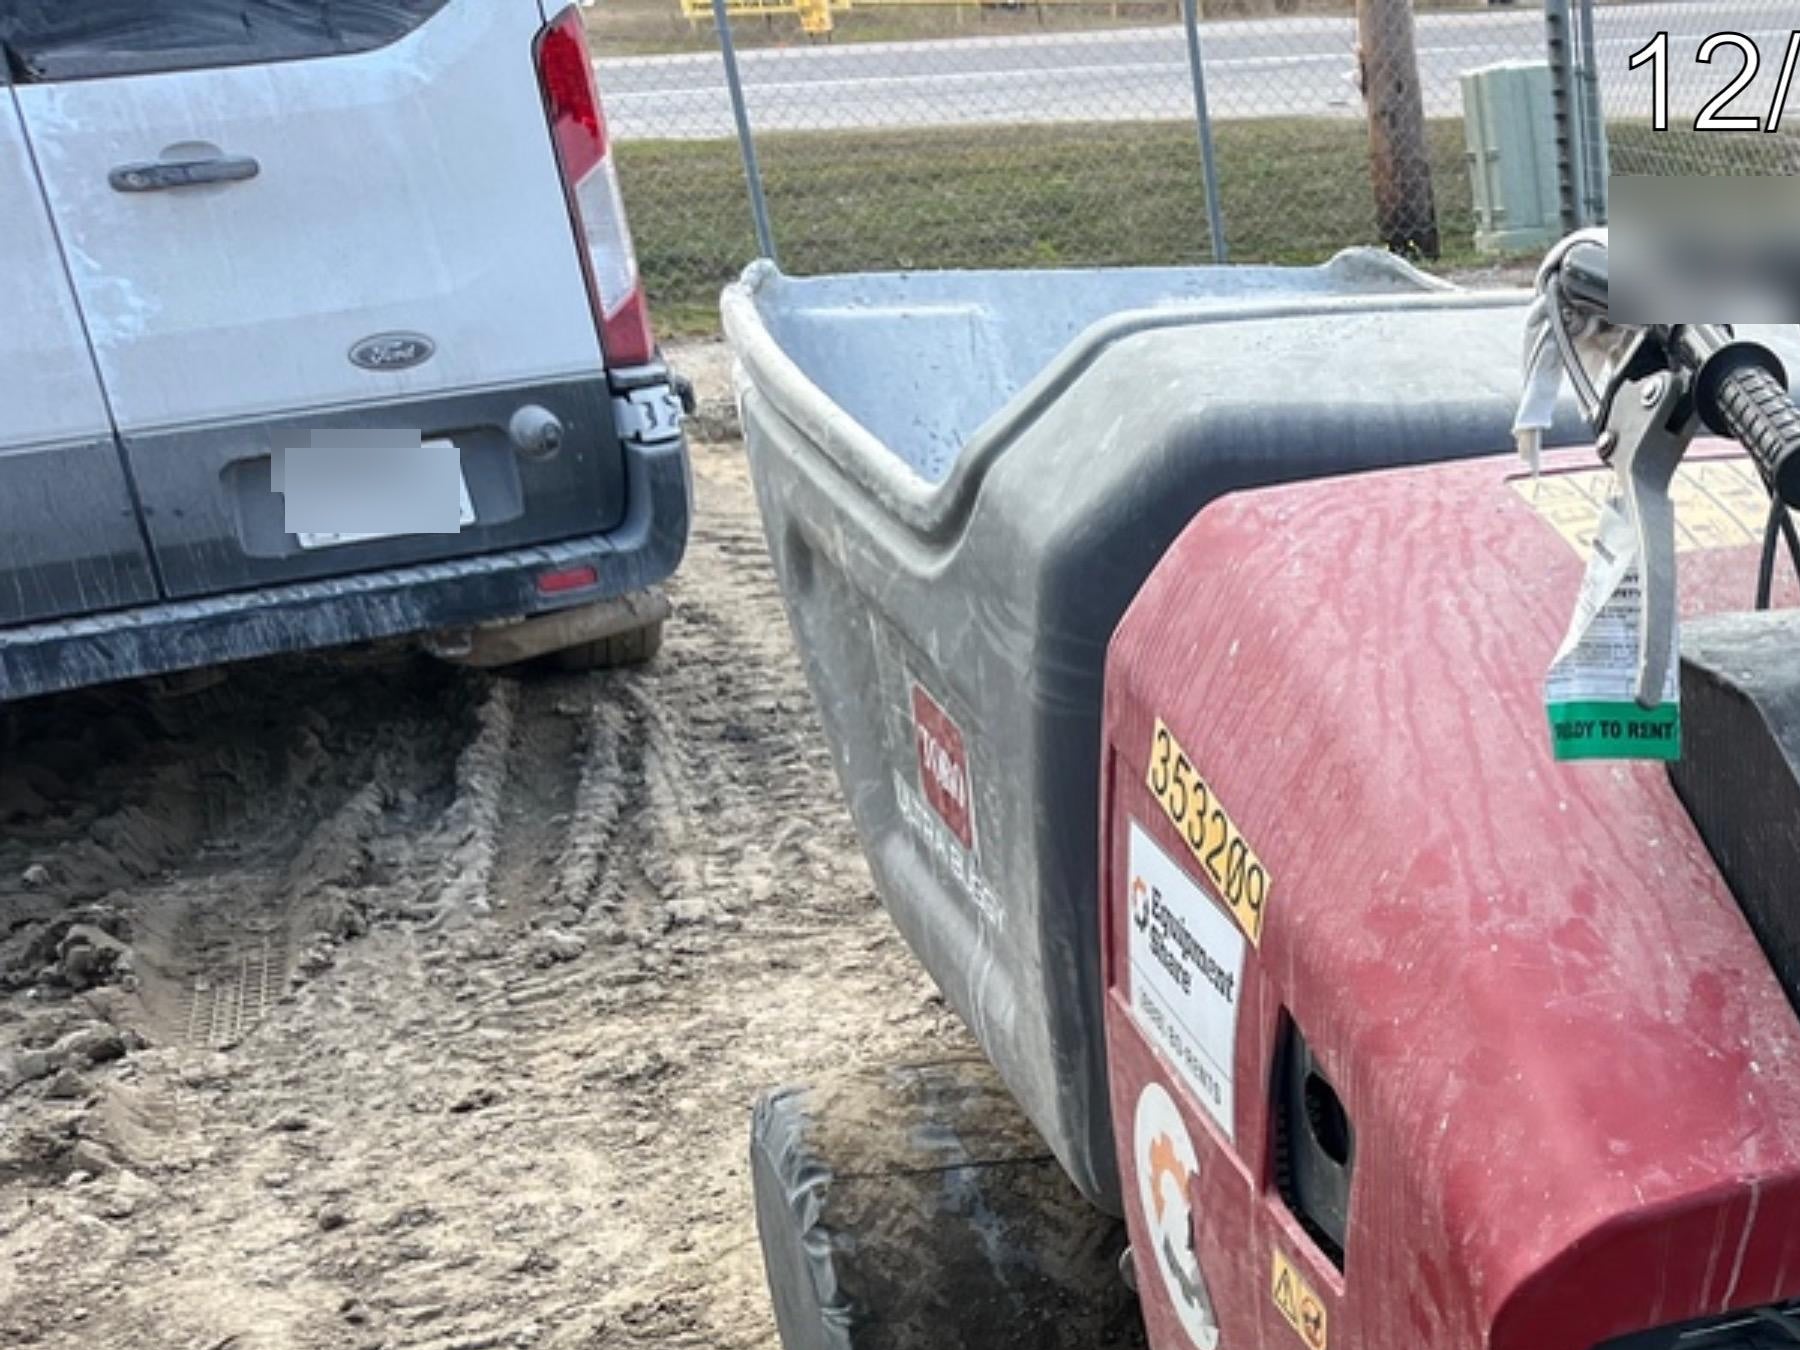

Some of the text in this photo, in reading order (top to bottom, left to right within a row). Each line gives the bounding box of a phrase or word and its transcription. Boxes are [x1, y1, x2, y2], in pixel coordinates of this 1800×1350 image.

[1600, 719, 1622, 739] TO
[1628, 720, 1674, 739] RENT
[1149, 923, 1192, 996] Share
[1150, 885, 1234, 1003] Equipment
